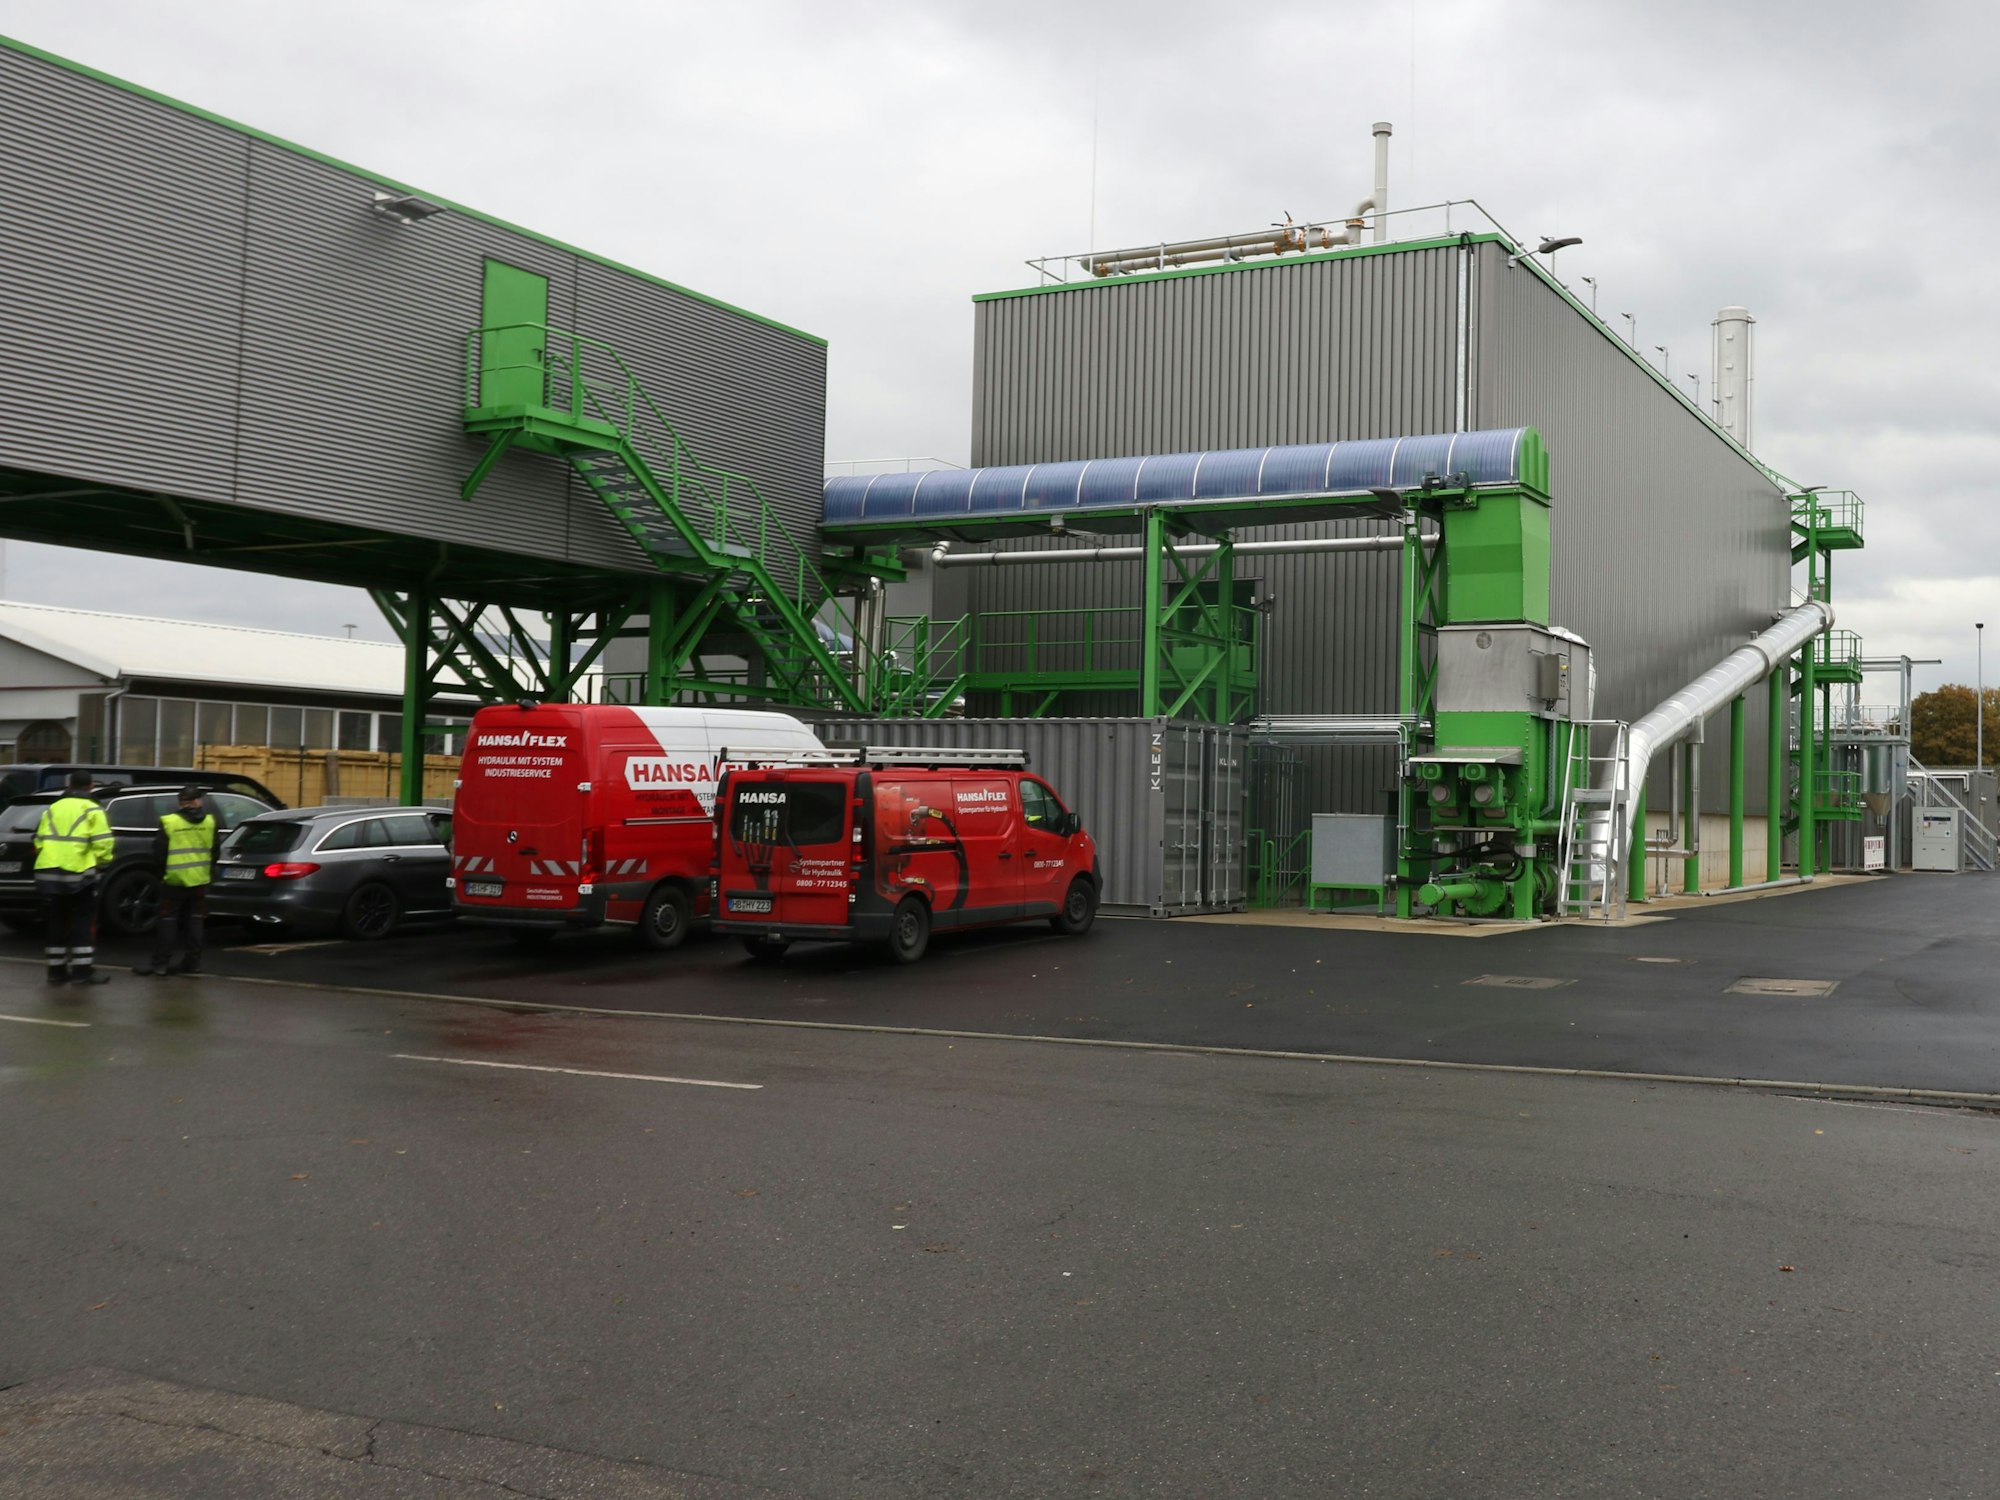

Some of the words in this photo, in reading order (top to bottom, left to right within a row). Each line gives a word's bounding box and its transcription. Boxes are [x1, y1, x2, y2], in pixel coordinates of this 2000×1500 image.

[478, 756, 516, 765] HYDRAULIK
[517, 756, 532, 765] MIT
[532, 757, 563, 766] SYSTEM
[485, 768, 552, 778] INDUSTRIESERVICE
[739, 792, 786, 804] HANSA
[799, 859, 845, 867] Systempartner
[811, 869, 842, 877] Hydraulik
